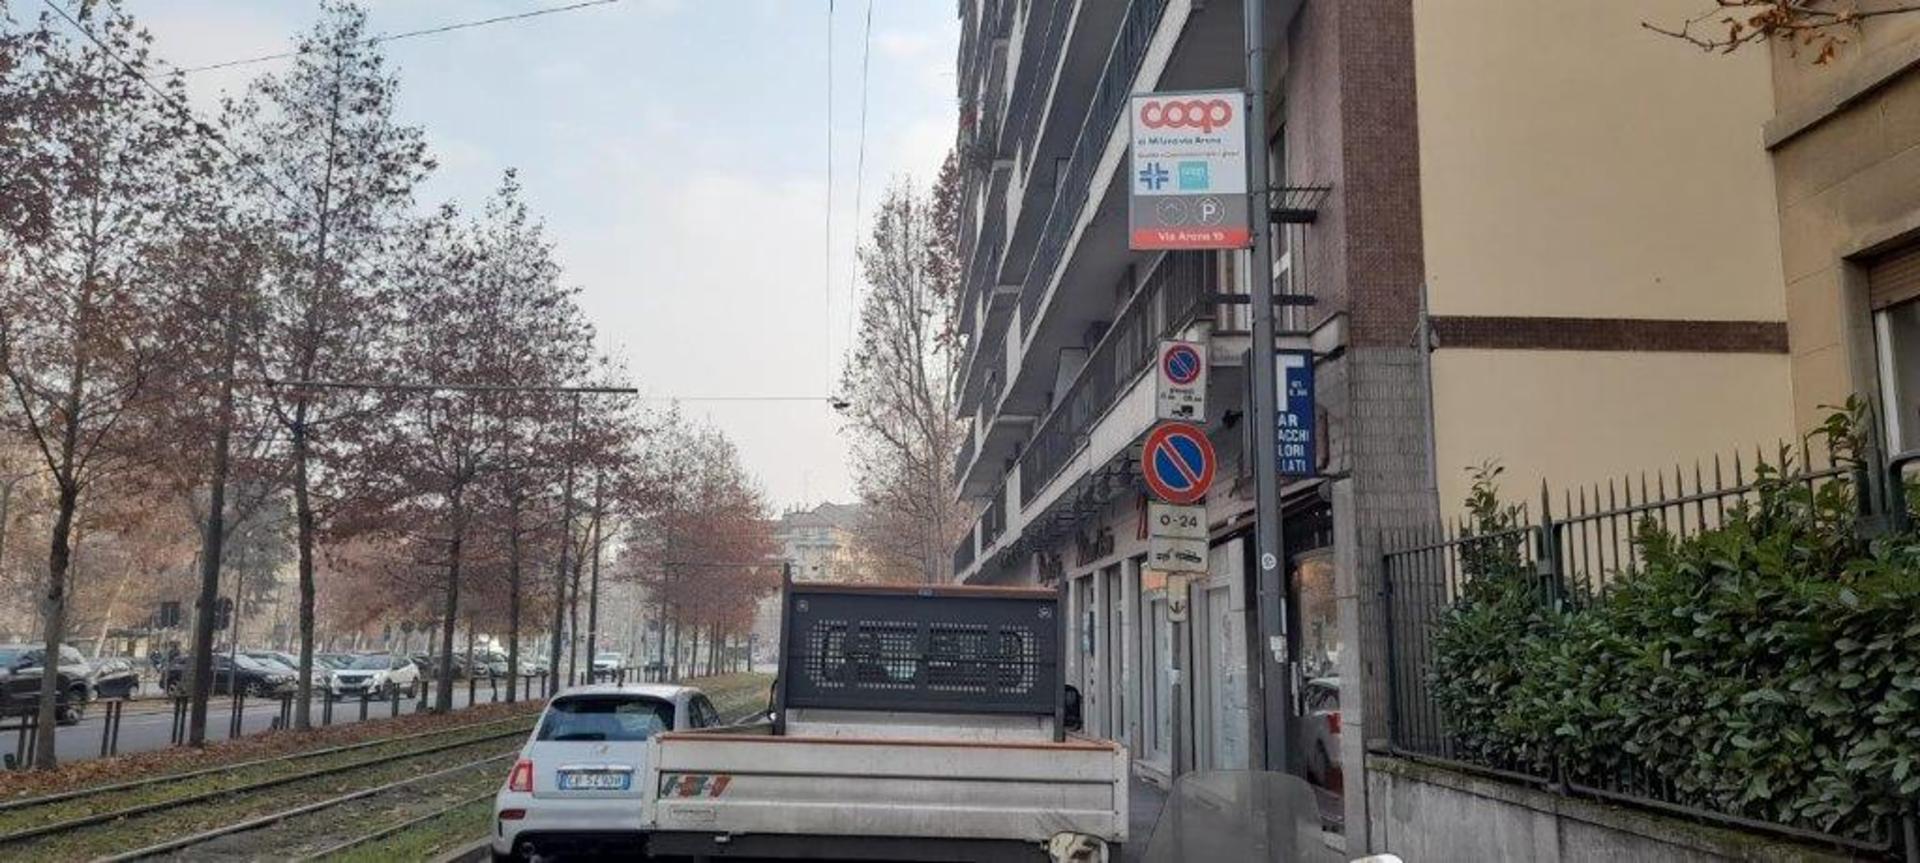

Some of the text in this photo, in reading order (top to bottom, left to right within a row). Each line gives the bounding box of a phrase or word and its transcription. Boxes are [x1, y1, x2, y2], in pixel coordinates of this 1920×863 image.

[1140, 100, 1232, 133] coop
[1278, 414, 1299, 427] AR
[1278, 429, 1310, 442] ACCHI
[1278, 444, 1305, 457] LORI
[1281, 459, 1307, 472] LATI
